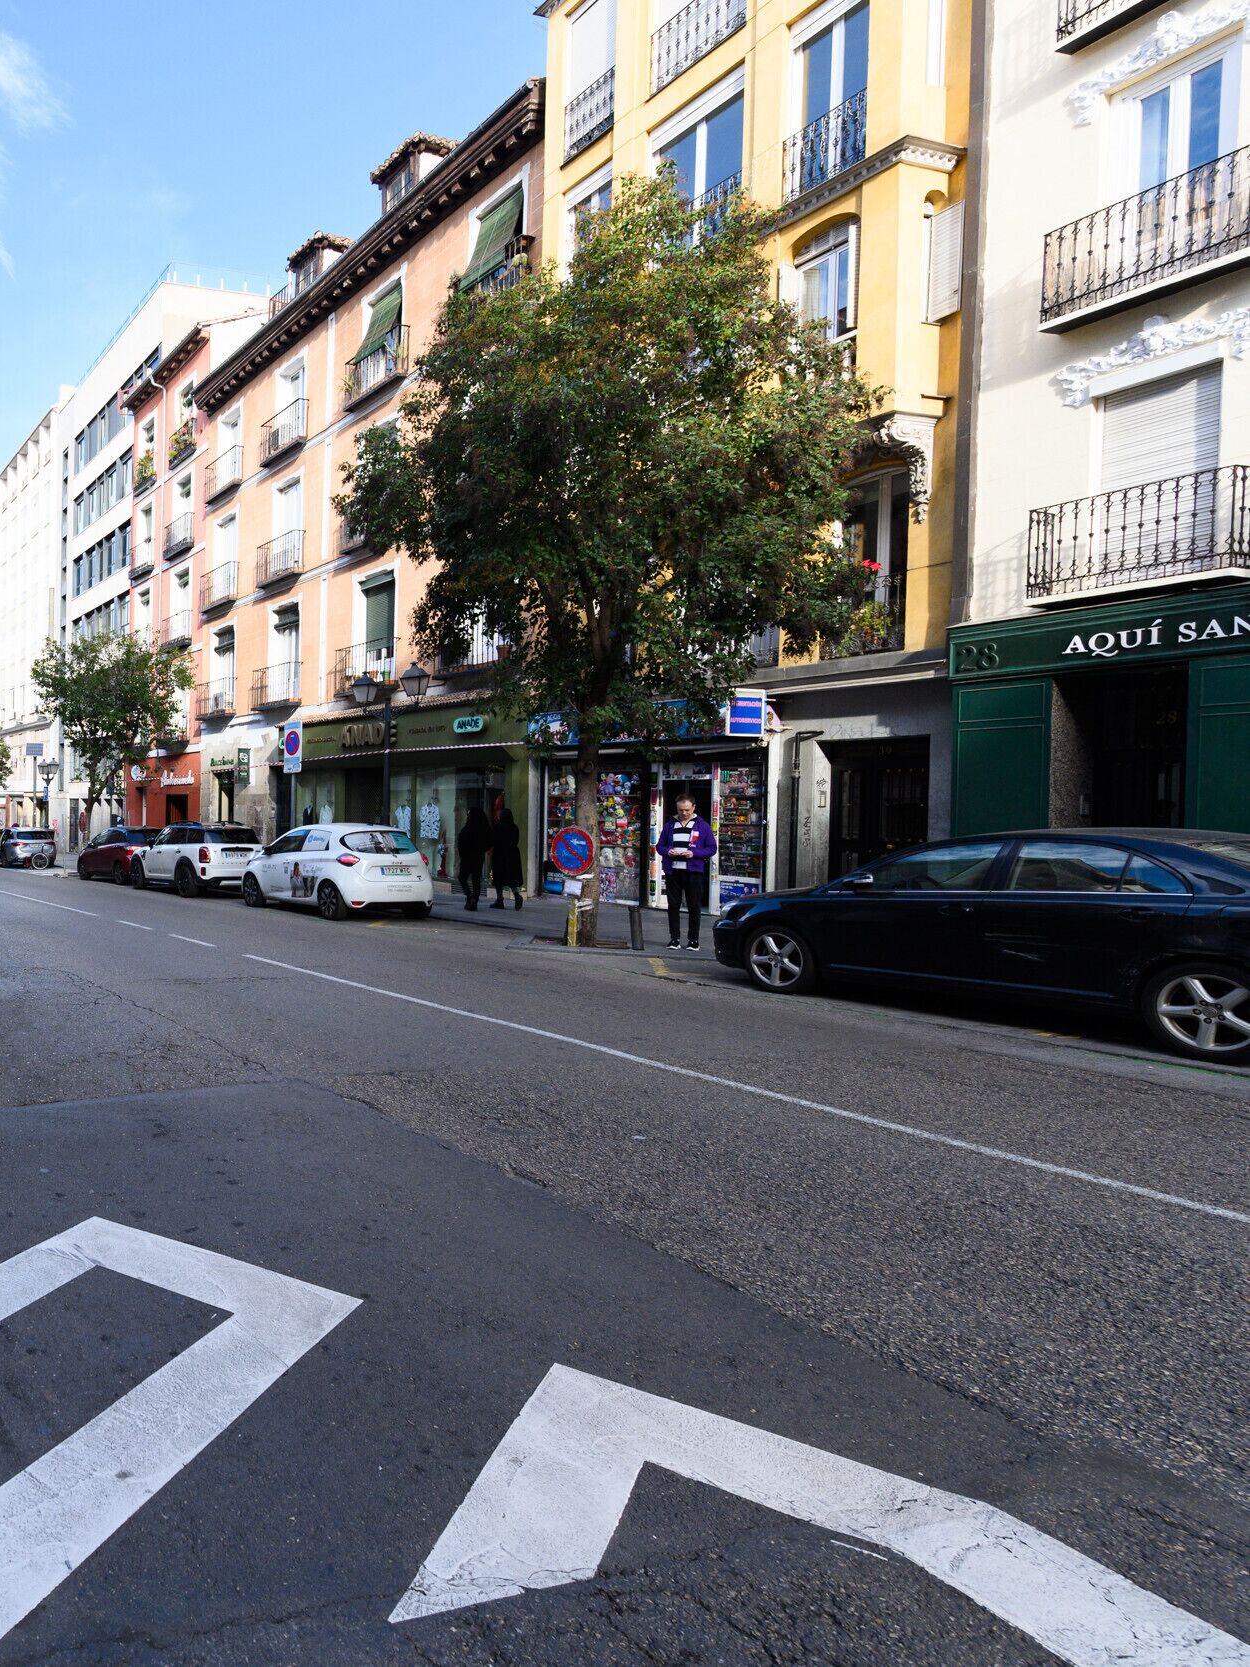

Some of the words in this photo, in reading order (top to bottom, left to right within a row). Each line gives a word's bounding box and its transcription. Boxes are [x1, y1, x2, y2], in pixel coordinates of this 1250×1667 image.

[1062, 619, 1163, 657] AQUÍ
[957, 642, 999, 672] 28
[456, 718, 481, 730] ANADE
